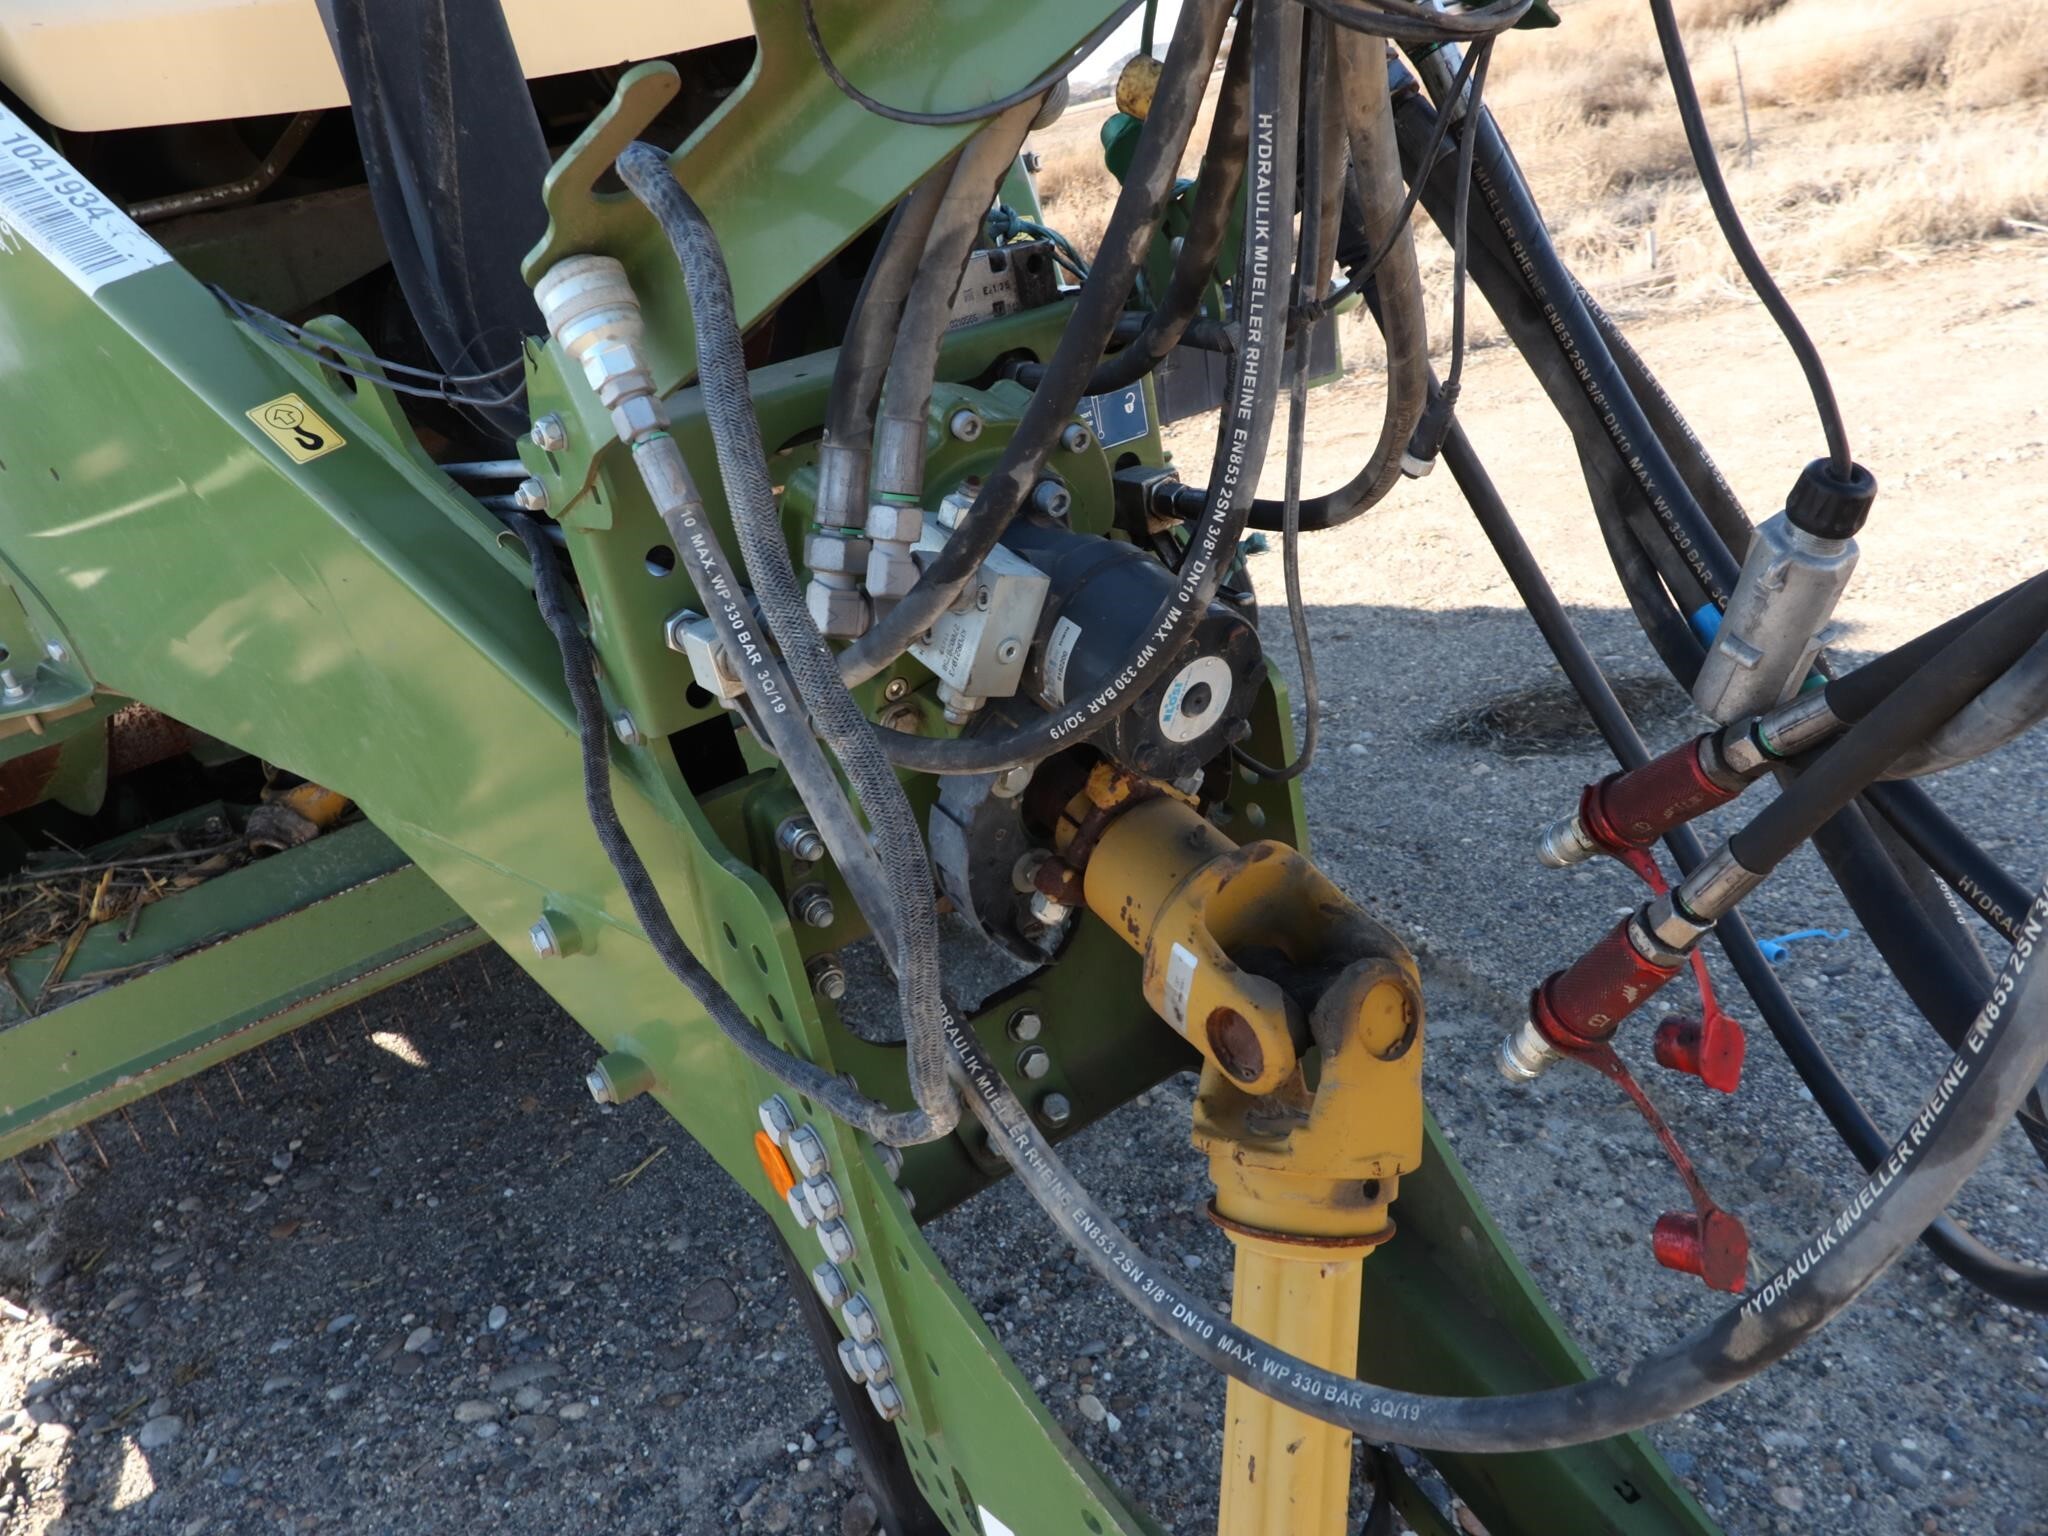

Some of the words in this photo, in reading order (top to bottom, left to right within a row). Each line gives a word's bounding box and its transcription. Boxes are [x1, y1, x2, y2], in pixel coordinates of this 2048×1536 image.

[2, 132, 115, 224] 1041934
[1254, 113, 1272, 241] HYDRAULIK
[1247, 245, 1269, 343] MUELLER
[1237, 347, 1261, 420] RHEINE
[1473, 164, 1516, 240] MUELLER
[1511, 241, 1547, 299] RHEINE
[1543, 303, 1574, 349] EN853
[1569, 350, 1592, 381] 2SN
[1603, 412, 1632, 454] DN10
[1653, 495, 1674, 520] WP
[1668, 520, 1692, 549] 330
[1686, 549, 1713, 584] BAR
[1224, 428, 1247, 487] EN853
[1216, 487, 1234, 524] 2SN
[1178, 561, 1206, 603] DN10
[690, 532, 716, 576] MAX.
[711, 573, 732, 600] WP
[724, 602, 745, 630] 330
[737, 628, 763, 667] BAR
[757, 669, 788, 715] 3Q/19
[1151, 607, 1182, 643] MAX.
[1114, 665, 1140, 692] 330
[1136, 644, 1157, 671] WP
[1050, 710, 1087, 741] 3Q/19
[1090, 685, 1118, 715] BAR
[1740, 1227, 1837, 1318] HYDRAULIK
[1836, 1140, 1914, 1236] MUELLER
[1910, 1056, 1969, 1145] RHEINE
[1968, 973, 2014, 1054] EN853
[2009, 917, 2043, 975] 2SN
[1072, 1207, 1116, 1255] EN853
[1113, 1251, 1144, 1283] 2SN
[1172, 1303, 1214, 1339] DN10
[1217, 1335, 1257, 1368] MAX.
[1262, 1357, 1291, 1380] WP
[1291, 1372, 1321, 1396] 330
[1324, 1386, 1363, 1409] BAR
[1370, 1398, 1421, 1422] 3Q/19
